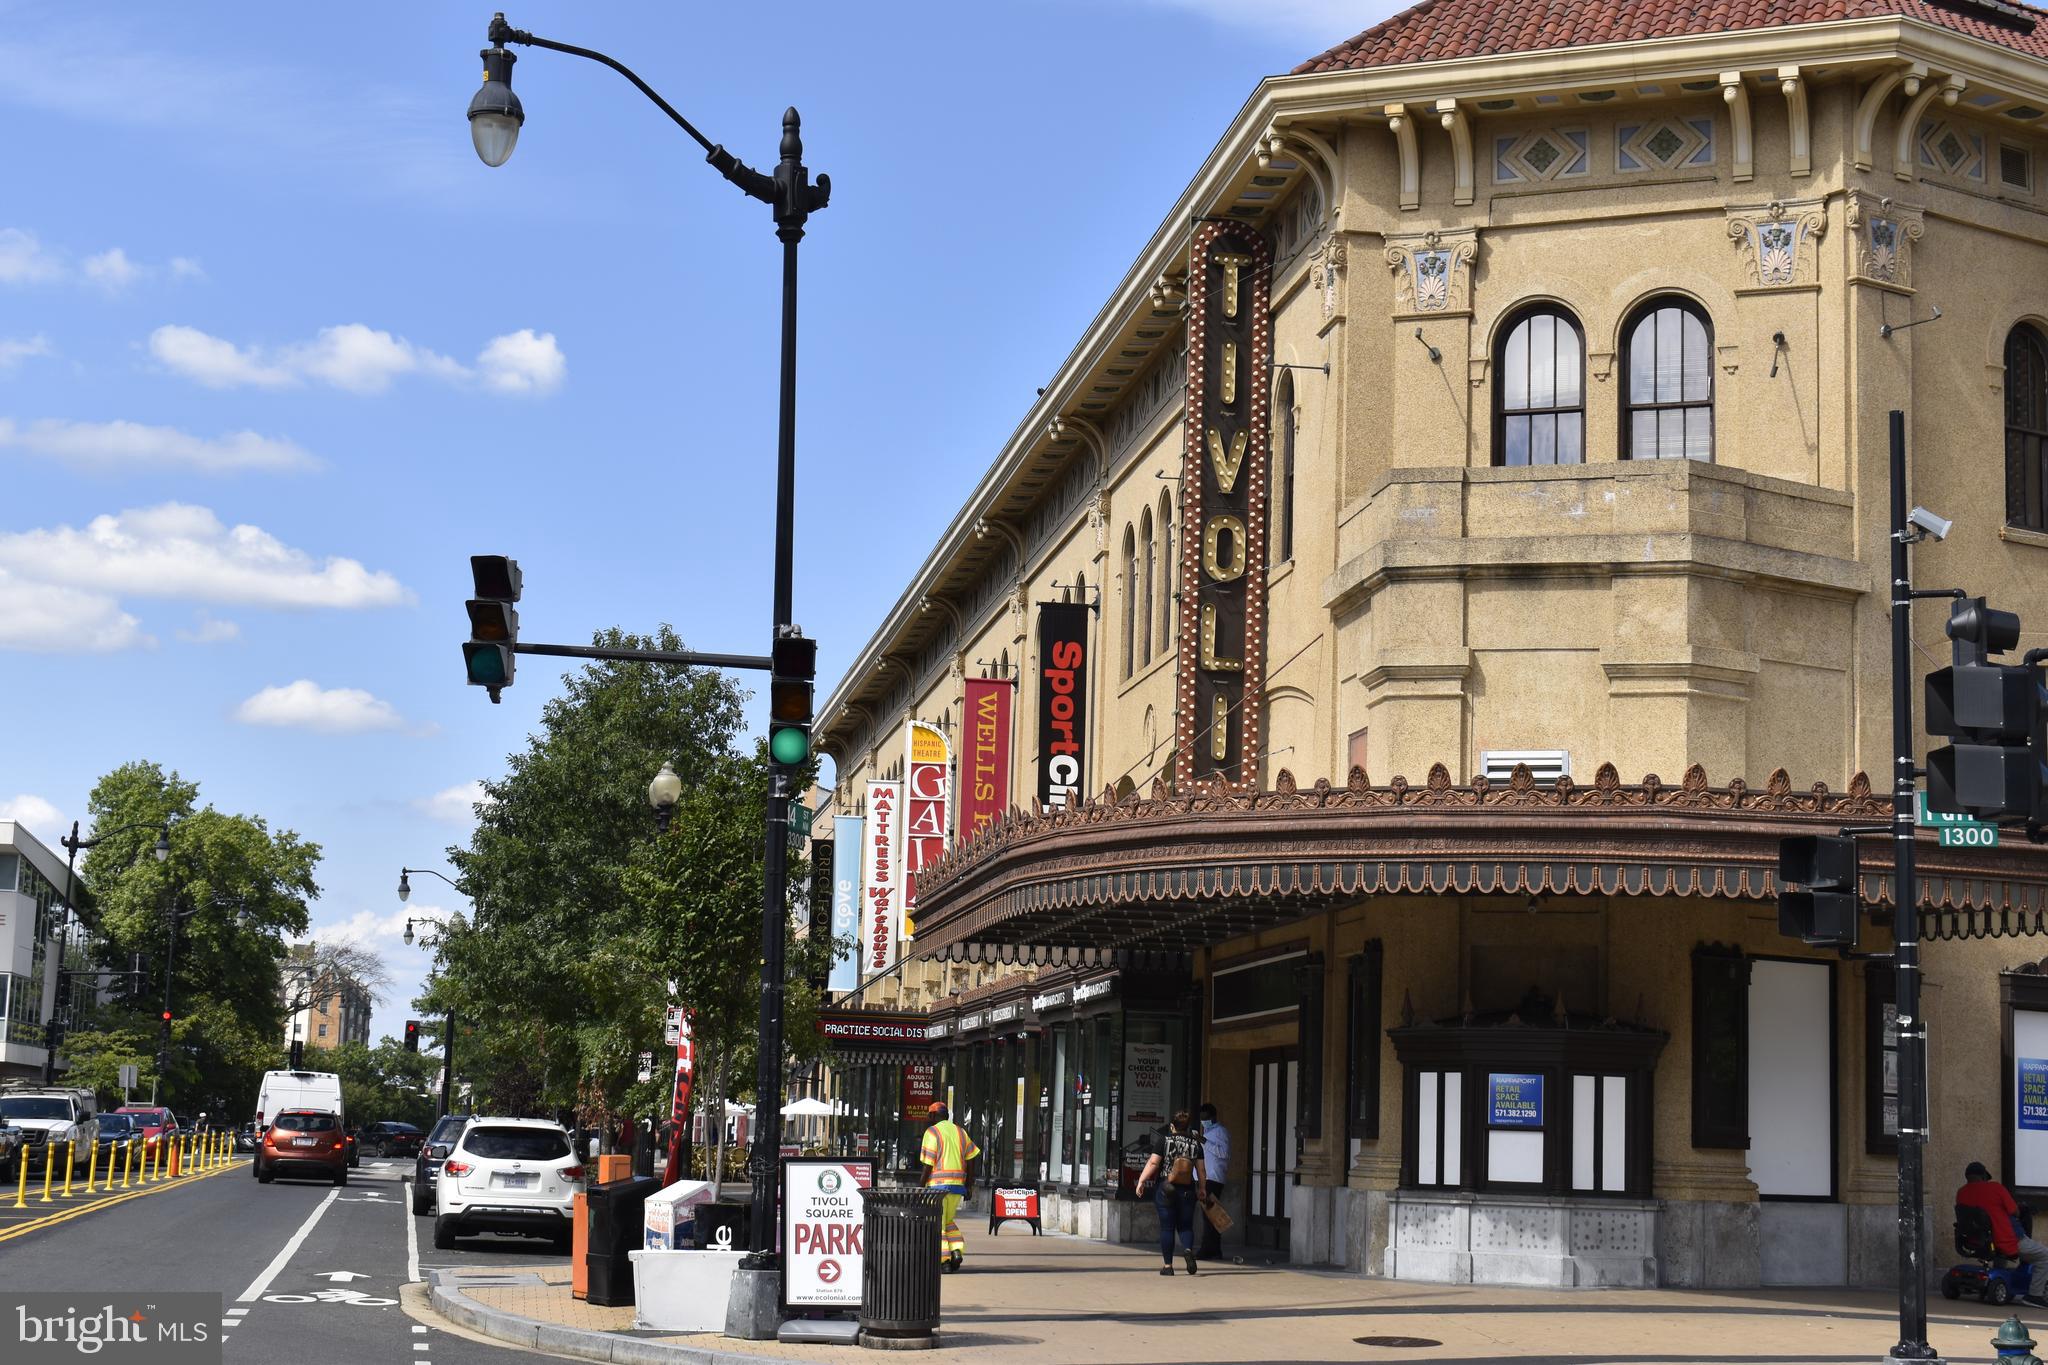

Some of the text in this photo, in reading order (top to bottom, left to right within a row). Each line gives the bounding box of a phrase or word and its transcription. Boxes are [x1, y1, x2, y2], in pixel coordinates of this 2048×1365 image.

[1200, 251, 1253, 762] TIVOLI
[913, 740, 942, 748] HISPANIC
[975, 692, 998, 801] WELLS
[913, 750, 941, 758] THEATRE
[787, 831, 804, 850] 3300
[1944, 828, 1993, 845] 1300
[868, 787, 895, 969] MATTRESS Warehouse
[837, 880, 853, 928] cove
[825, 1024, 871, 1035] PRACTICE
[872, 1026, 904, 1037] SOCIAL
[1128, 1064, 1156, 1072] CHECK
[1135, 1072, 1162, 1080] YOUR
[2024, 1073, 2047, 1083] RETAIL
[1496, 1085, 1521, 1093] RETAIL
[2024, 1085, 2046, 1094] SPACE
[1496, 1093, 1520, 1101] SPACE
[1496, 1101, 1536, 1109] AVAILABLE
[1495, 1109, 1537, 1117] 571.382.1290
[810, 1197, 848, 1206] TIVOLI
[1004, 1200, 1027, 1208] WE'RE
[806, 1209, 853, 1218] SQUARE
[1005, 1208, 1027, 1216] OPEN!
[794, 1223, 863, 1255] PARK
